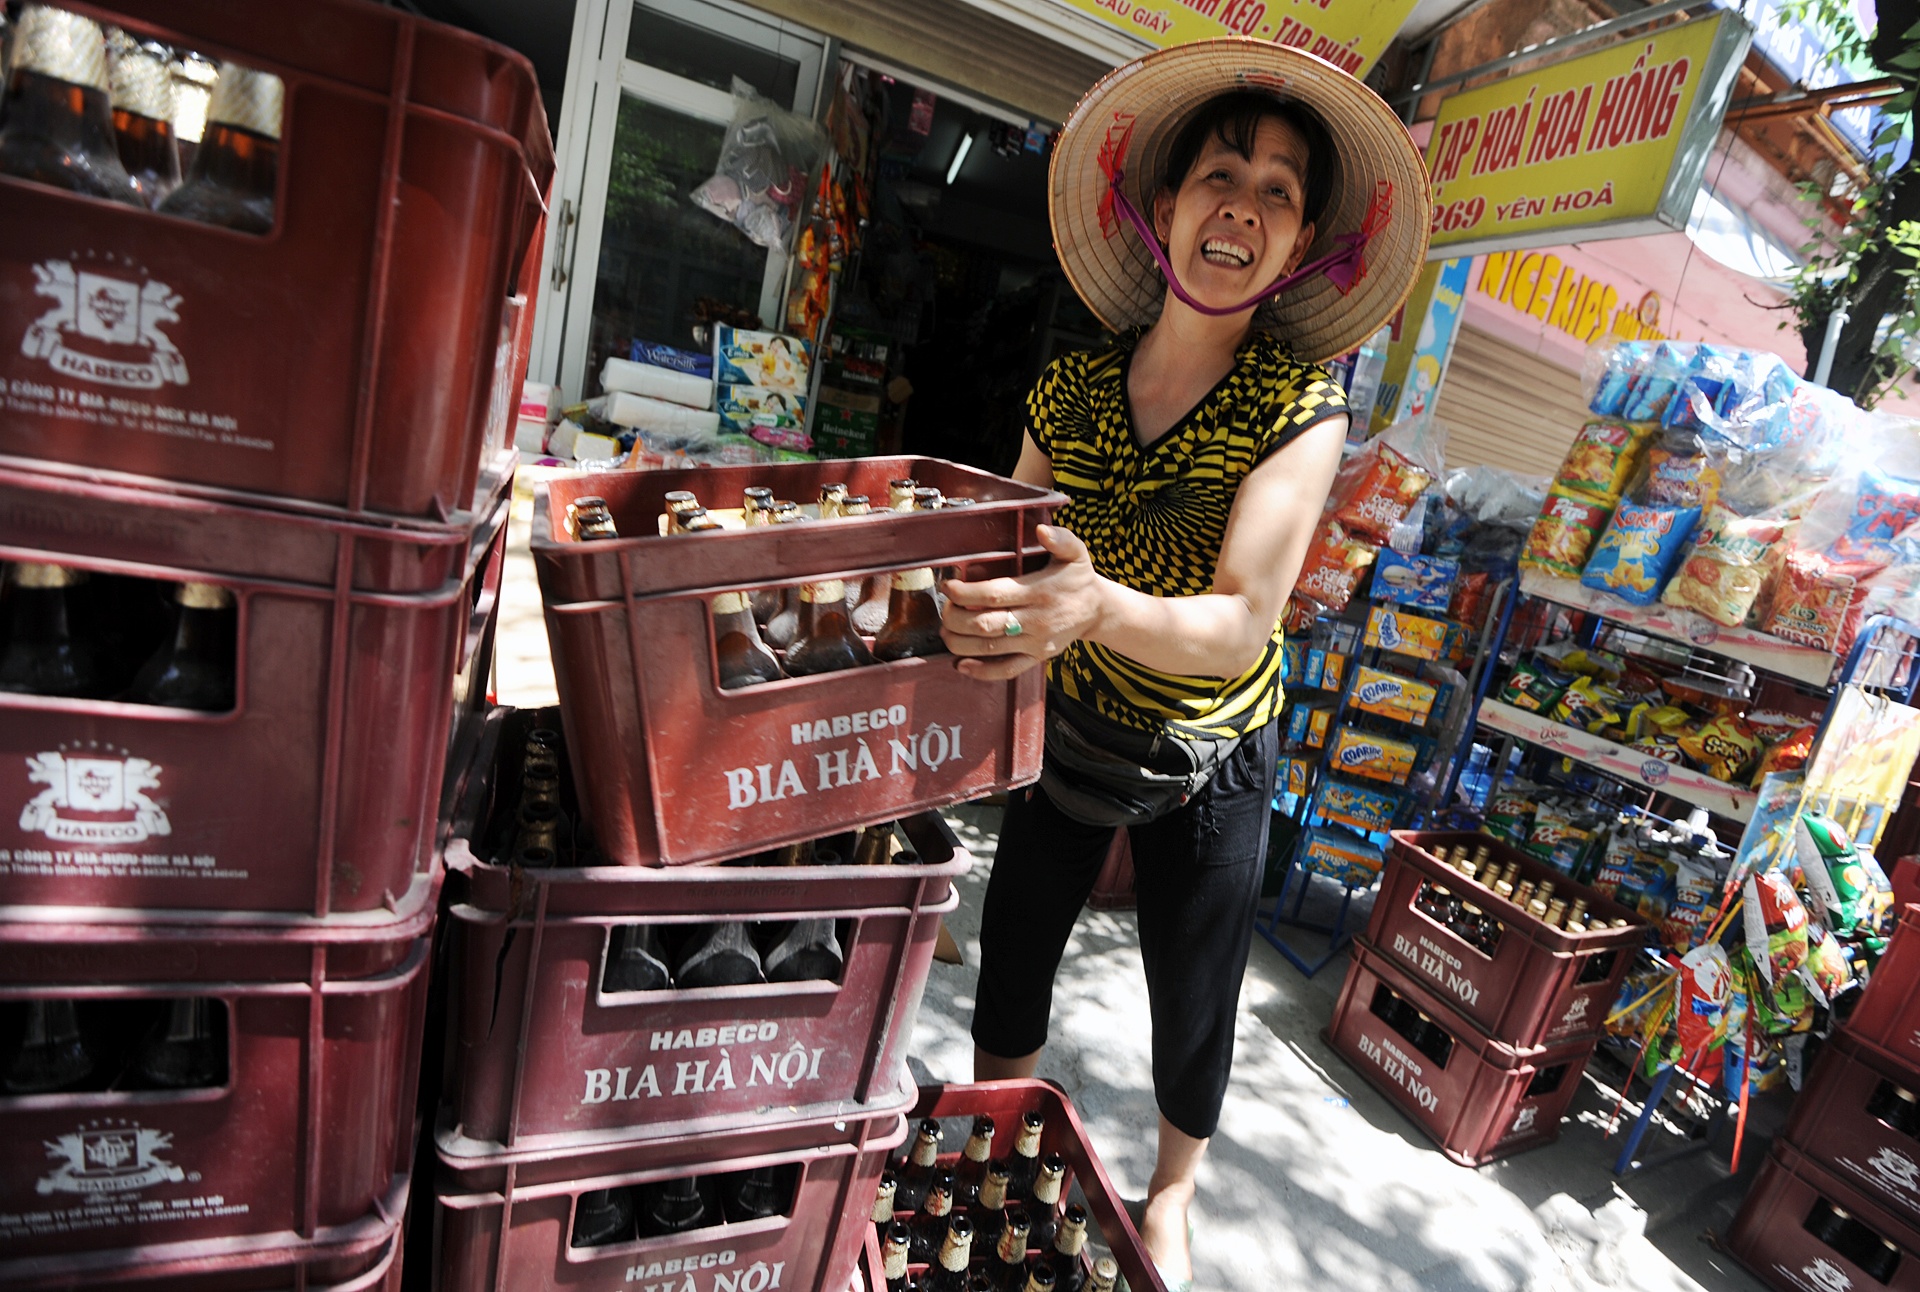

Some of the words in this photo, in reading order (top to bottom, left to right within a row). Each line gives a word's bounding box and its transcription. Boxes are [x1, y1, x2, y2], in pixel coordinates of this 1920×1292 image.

[1132, 7, 1174, 35] GIẤY
[1217, 2, 1266, 37] KẸO
[1471, 87, 1537, 176] HOÁ
[1525, 85, 1593, 165] HOA
[1586, 44, 1690, 152] HỒNG
[1431, 196, 1486, 234] 269
[1496, 197, 1546, 222] YÊN
[1551, 181, 1614, 213] HOÀ
[1477, 250, 1562, 322] NICE
[1546, 266, 1619, 346] KIDS
[60, 355, 155, 386] HABECO
[842, 369, 880, 385] Heineken
[822, 422, 867, 440] Heineken
[1600, 529, 1661, 556] CONES
[790, 704, 907, 746] HABECO
[723, 759, 808, 811] BIA
[815, 737, 882, 792] HÀ
[888, 722, 964, 777] NỘI
[56, 824, 139, 840] HABECO
[1393, 933, 1418, 963] BIA
[1420, 953, 1445, 983] HÀ
[1446, 973, 1480, 1007] NỘI
[1419, 935, 1462, 970] HABECO
[650, 1021, 779, 1051] HABECO
[581, 1064, 663, 1105] BIA
[671, 1047, 737, 1096] HÀ
[746, 1040, 826, 1089] NỘI
[1357, 1033, 1381, 1065] BIA
[1382, 1052, 1407, 1086] HÀ
[1406, 1078, 1440, 1114] NỘI
[1382, 1037, 1423, 1077] HABECO
[625, 1250, 737, 1283] HABECO
